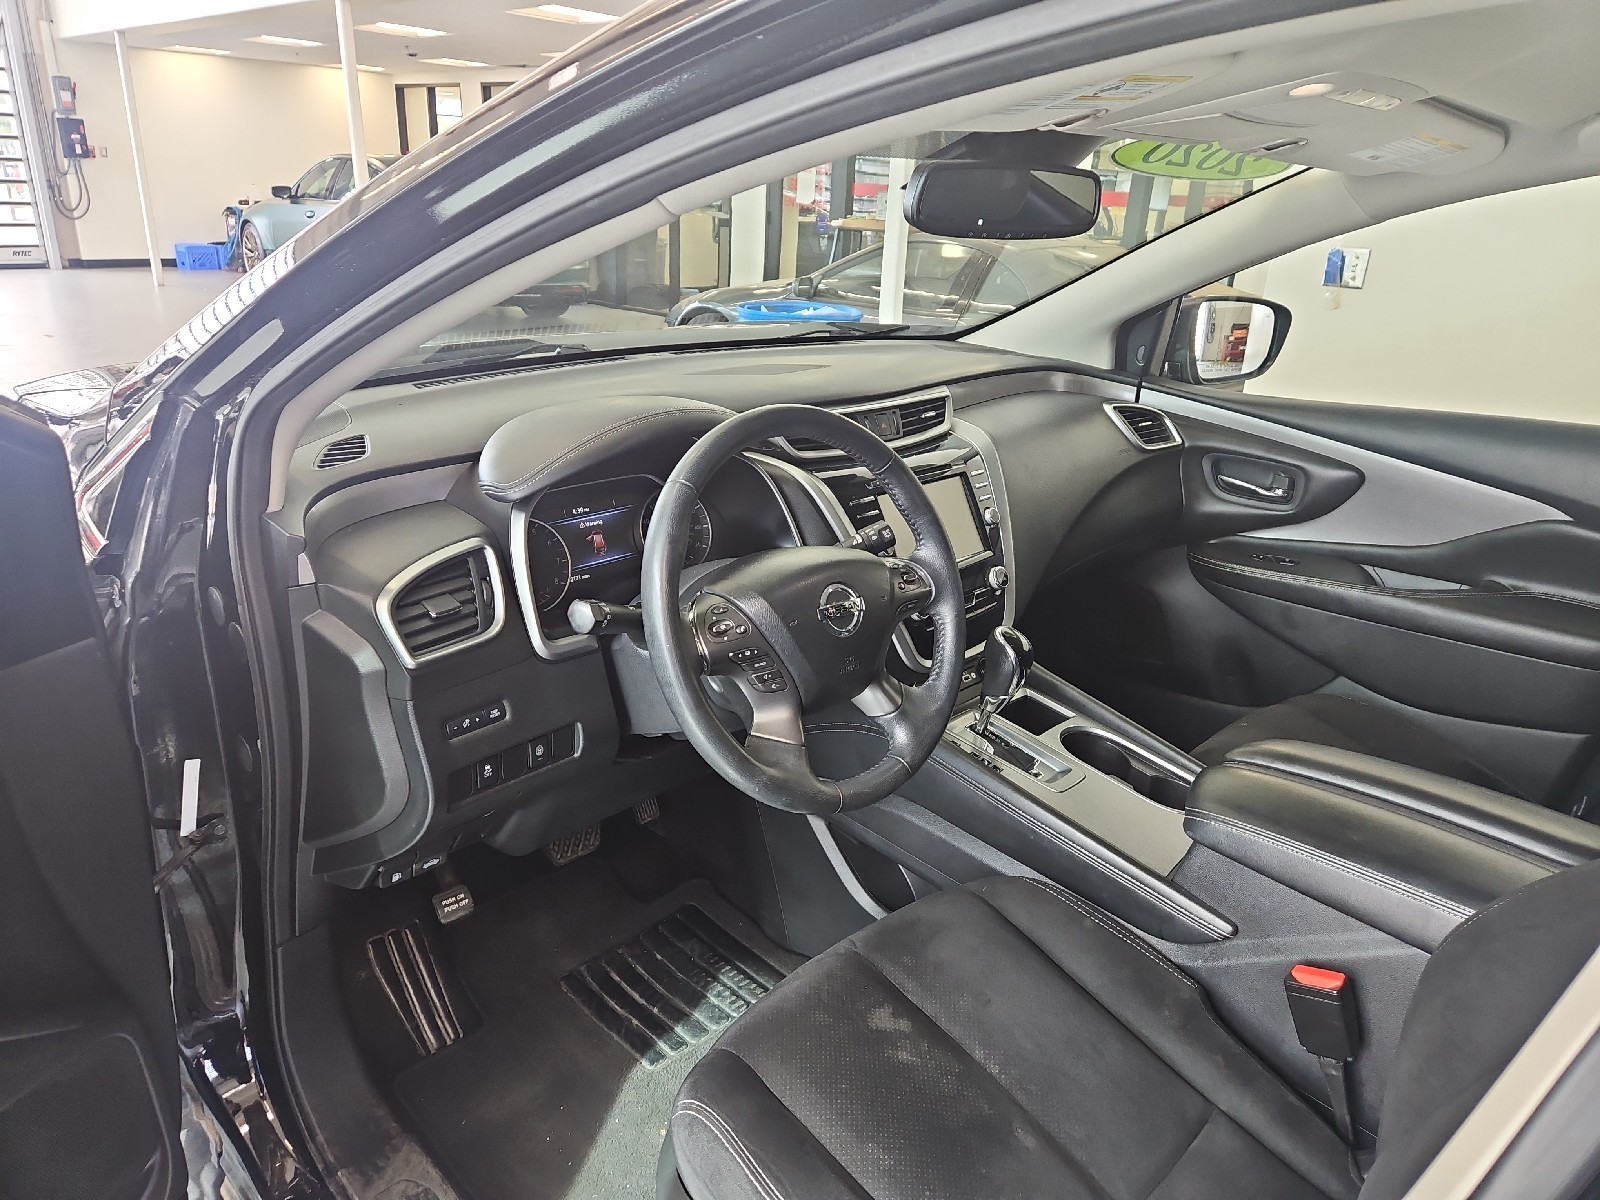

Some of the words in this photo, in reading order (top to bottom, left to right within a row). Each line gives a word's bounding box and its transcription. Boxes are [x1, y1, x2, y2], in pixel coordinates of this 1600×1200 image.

[441, 897, 456, 906] PUSH
[444, 904, 458, 913] PUSH
[459, 899, 468, 907] OFF
